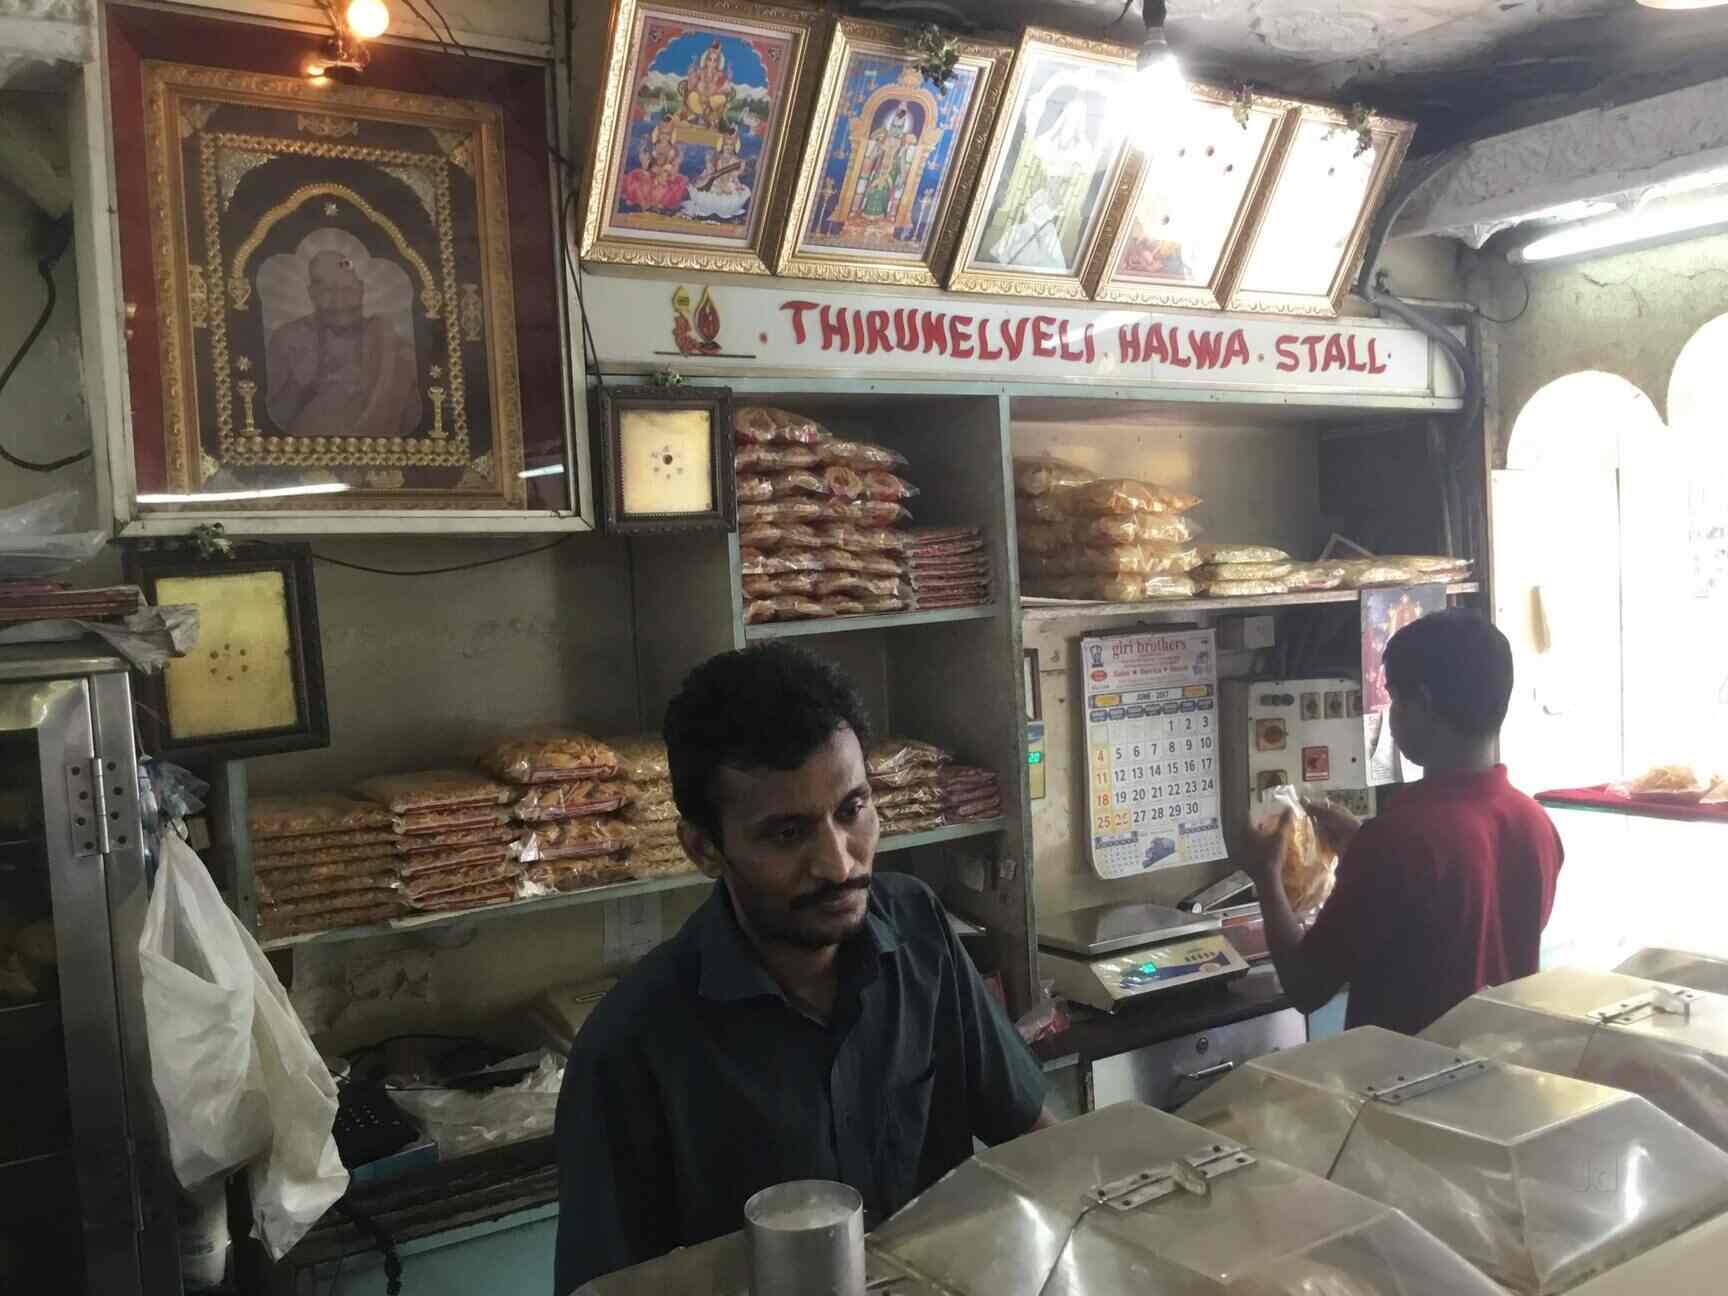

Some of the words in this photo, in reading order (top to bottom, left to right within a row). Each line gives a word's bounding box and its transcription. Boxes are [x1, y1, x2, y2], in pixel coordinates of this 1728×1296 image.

[780, 300, 1095, 364] THIRUNELVELI
[1119, 322, 1250, 369] HALWA
[1275, 333, 1387, 374] STALL
[1168, 720, 1174, 732] 1
[1185, 718, 1192, 730] 2
[1202, 716, 1208, 728] 3
[1116, 748, 1122, 760] 5
[1134, 746, 1140, 757] 6
[1152, 744, 1157, 756] 7
[1168, 741, 1176, 752] 8
[1186, 739, 1192, 750] 9
[1200, 737, 1212, 748] 10
[1097, 772, 1108, 784] 11
[1115, 770, 1126, 782] 12
[1132, 767, 1143, 778] 13
[1150, 764, 1160, 776] 14
[1168, 762, 1178, 774] 15
[1184, 760, 1196, 772] 16
[1201, 758, 1212, 769] 17
[1097, 794, 1109, 806] 18
[1115, 791, 1126, 804] 19
[1132, 788, 1146, 801] 20
[1152, 786, 1162, 798] 21
[1168, 784, 1180, 796] 22
[1185, 781, 1197, 793] 23
[1202, 778, 1214, 791] 24
[1097, 816, 1110, 828] 25
[1115, 813, 1128, 826] 26
[1134, 810, 1146, 822] 27
[1152, 808, 1164, 820] 28
[1168, 804, 1180, 817] 29
[1186, 801, 1198, 814] 30
